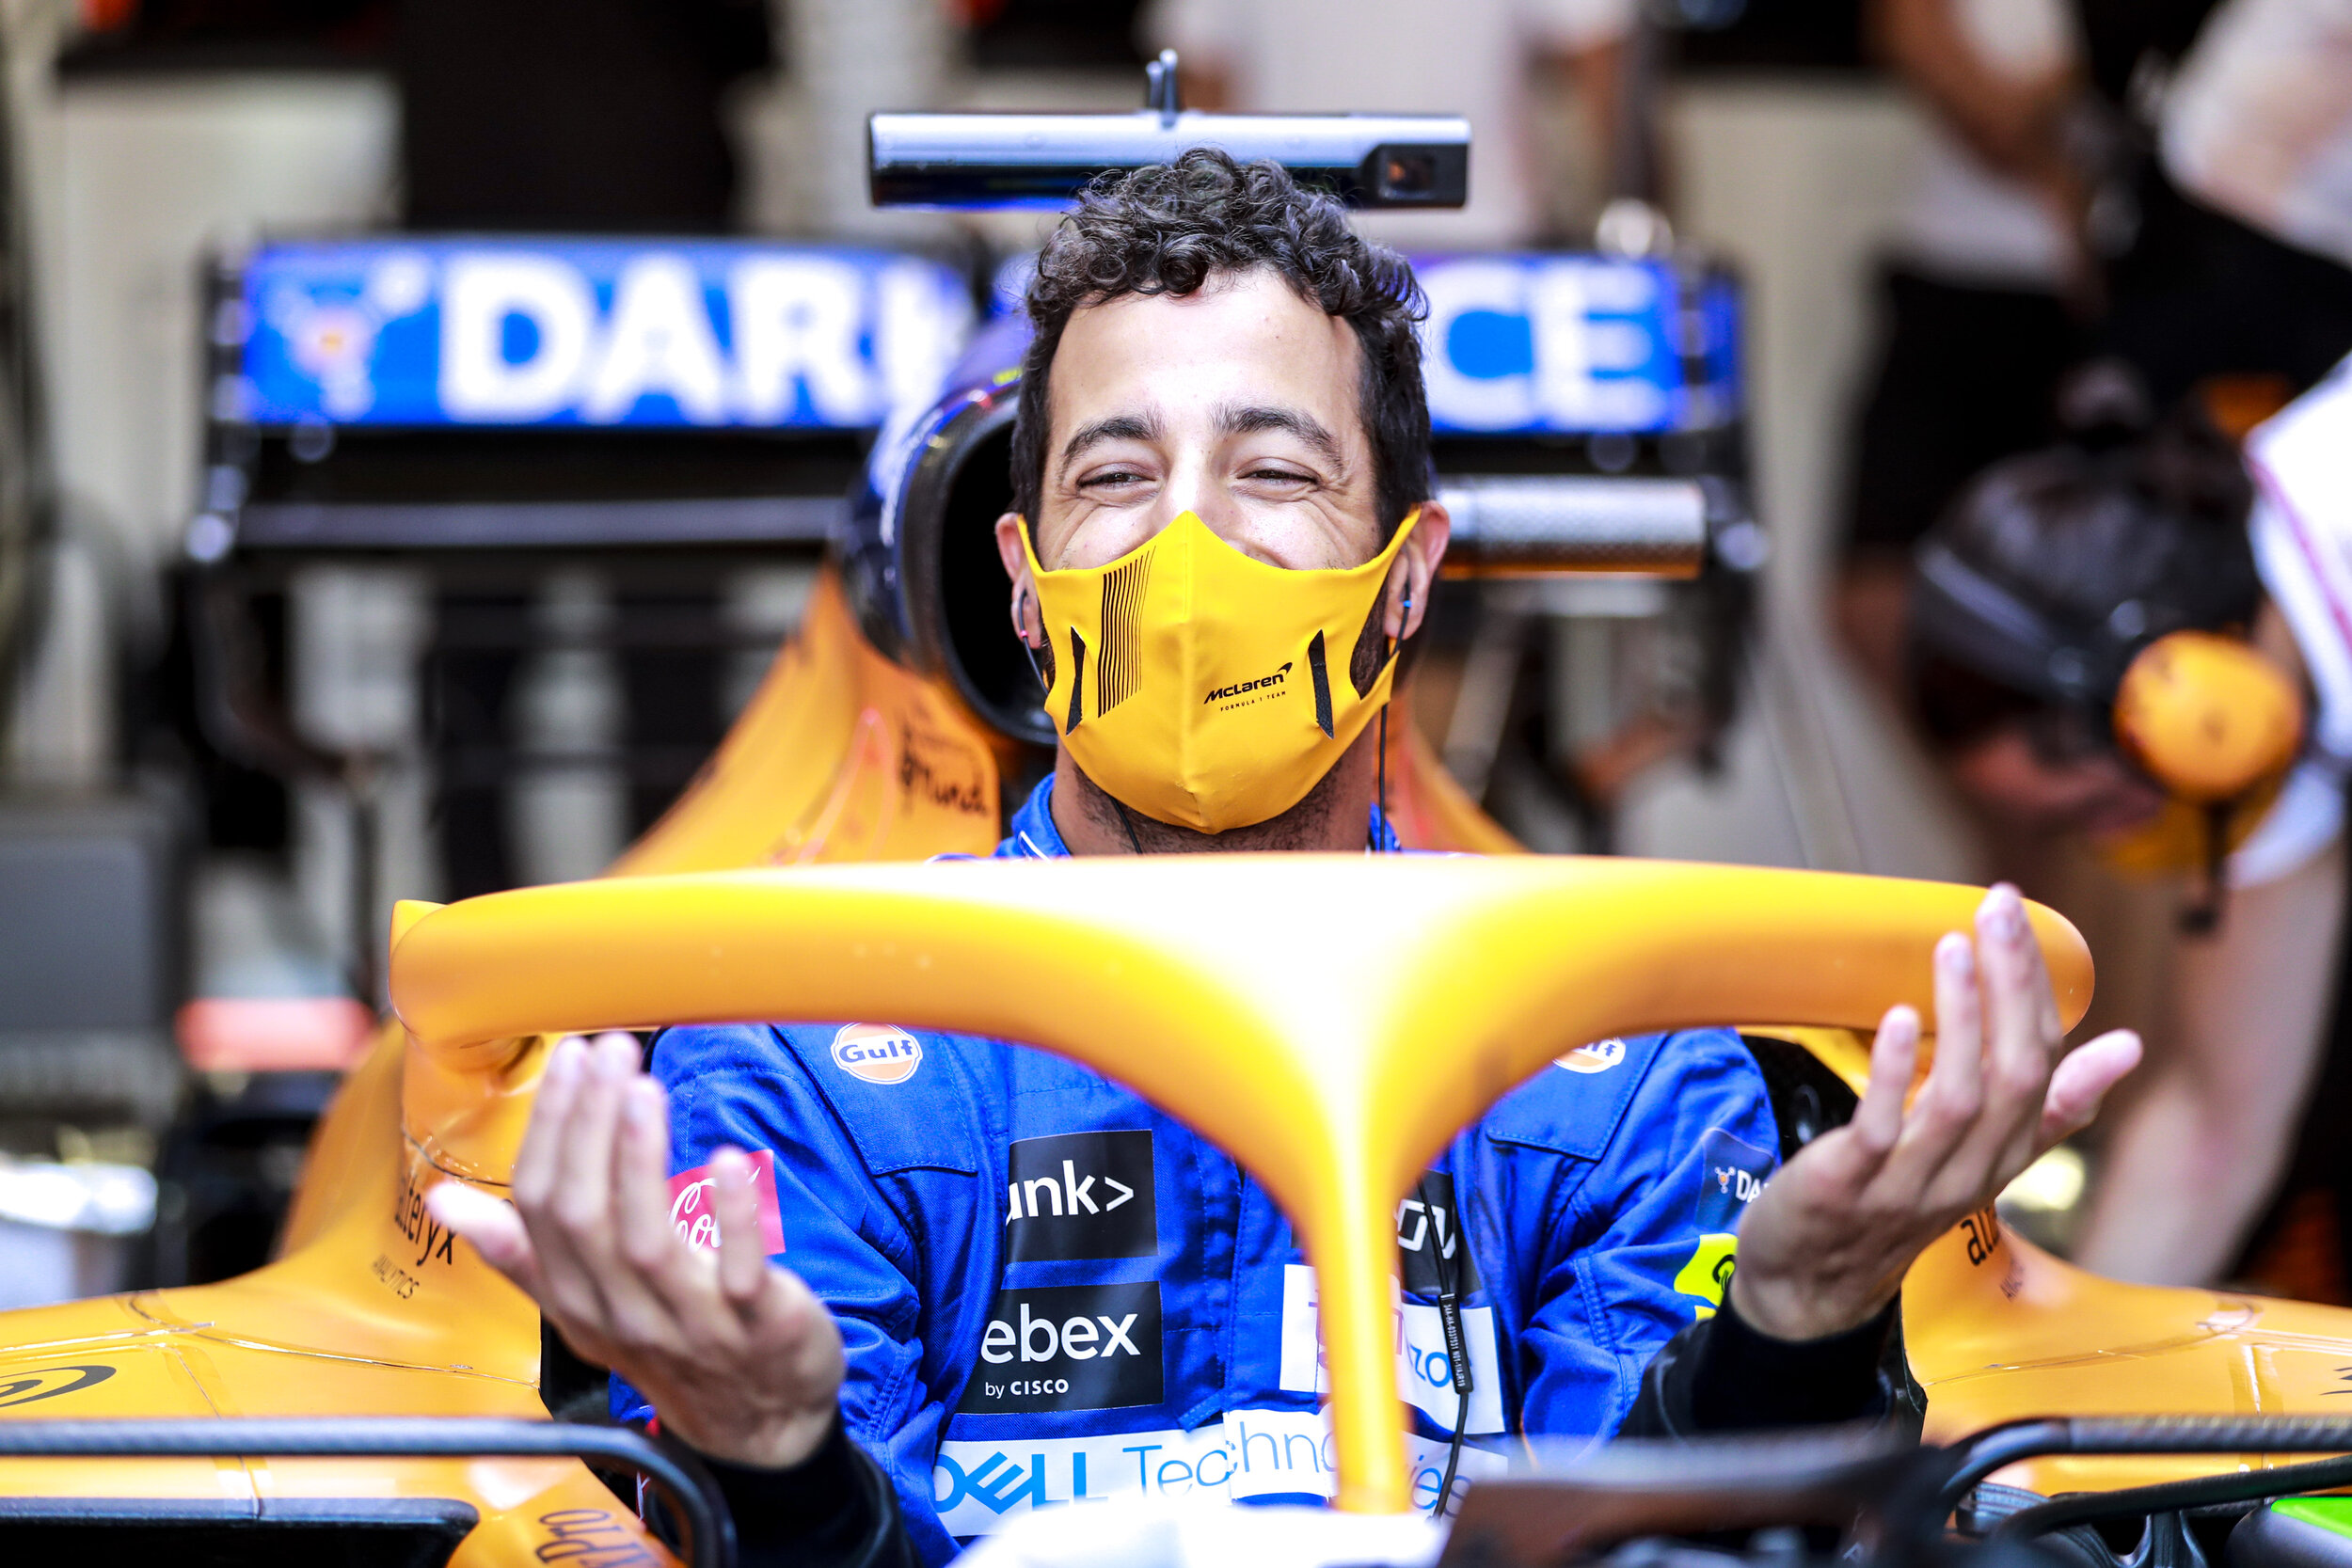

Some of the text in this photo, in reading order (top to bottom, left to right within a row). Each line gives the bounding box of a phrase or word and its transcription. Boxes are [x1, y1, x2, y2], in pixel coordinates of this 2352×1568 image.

[1203, 673, 1285, 705] McLaren
[1220, 699, 1255, 712] FORMULA
[1266, 690, 1286, 700] TEAM
[838, 1039, 914, 1064] Gulf
[980, 1303, 1141, 1364] ebex
[985, 1378, 1069, 1399] by CISCO
[932, 1451, 1108, 1515] DELL
